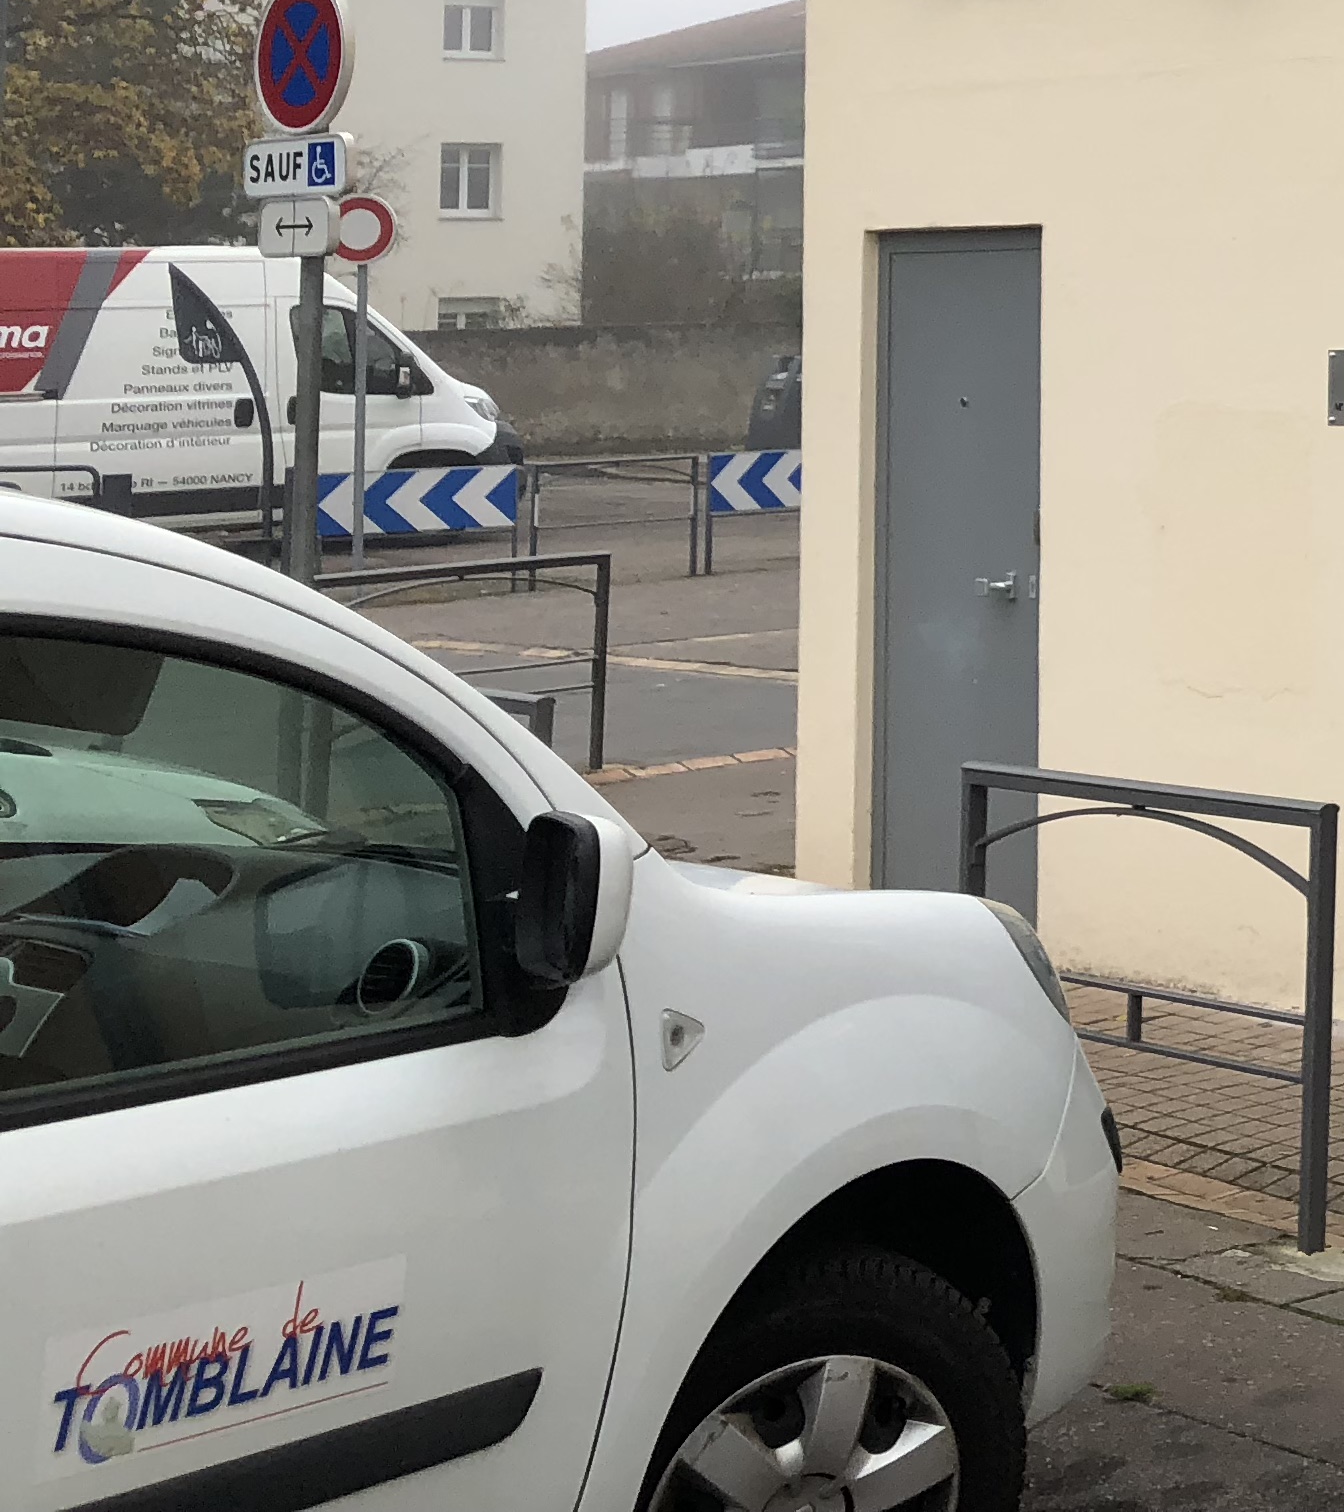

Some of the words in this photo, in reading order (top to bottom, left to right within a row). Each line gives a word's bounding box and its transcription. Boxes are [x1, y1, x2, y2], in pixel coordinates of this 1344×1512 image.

[249, 150, 304, 184] SAUF
[141, 364, 189, 376] Stands
[123, 384, 190, 395] Panneaux
[193, 381, 233, 392] divers
[111, 401, 183, 414] Décoration
[186, 398, 233, 410] vitrines
[101, 420, 168, 433] Marquage
[171, 417, 232, 430] véhicules
[90, 440, 162, 453] Décoration
[166, 437, 231, 448] d'intérieur
[172, 476, 207, 486] 54000
[210, 473, 253, 485] NANCY
[76, 1326, 254, 1396] Commune
[281, 1280, 326, 1339] de
[53, 1305, 400, 1465] TOMBLAINE
